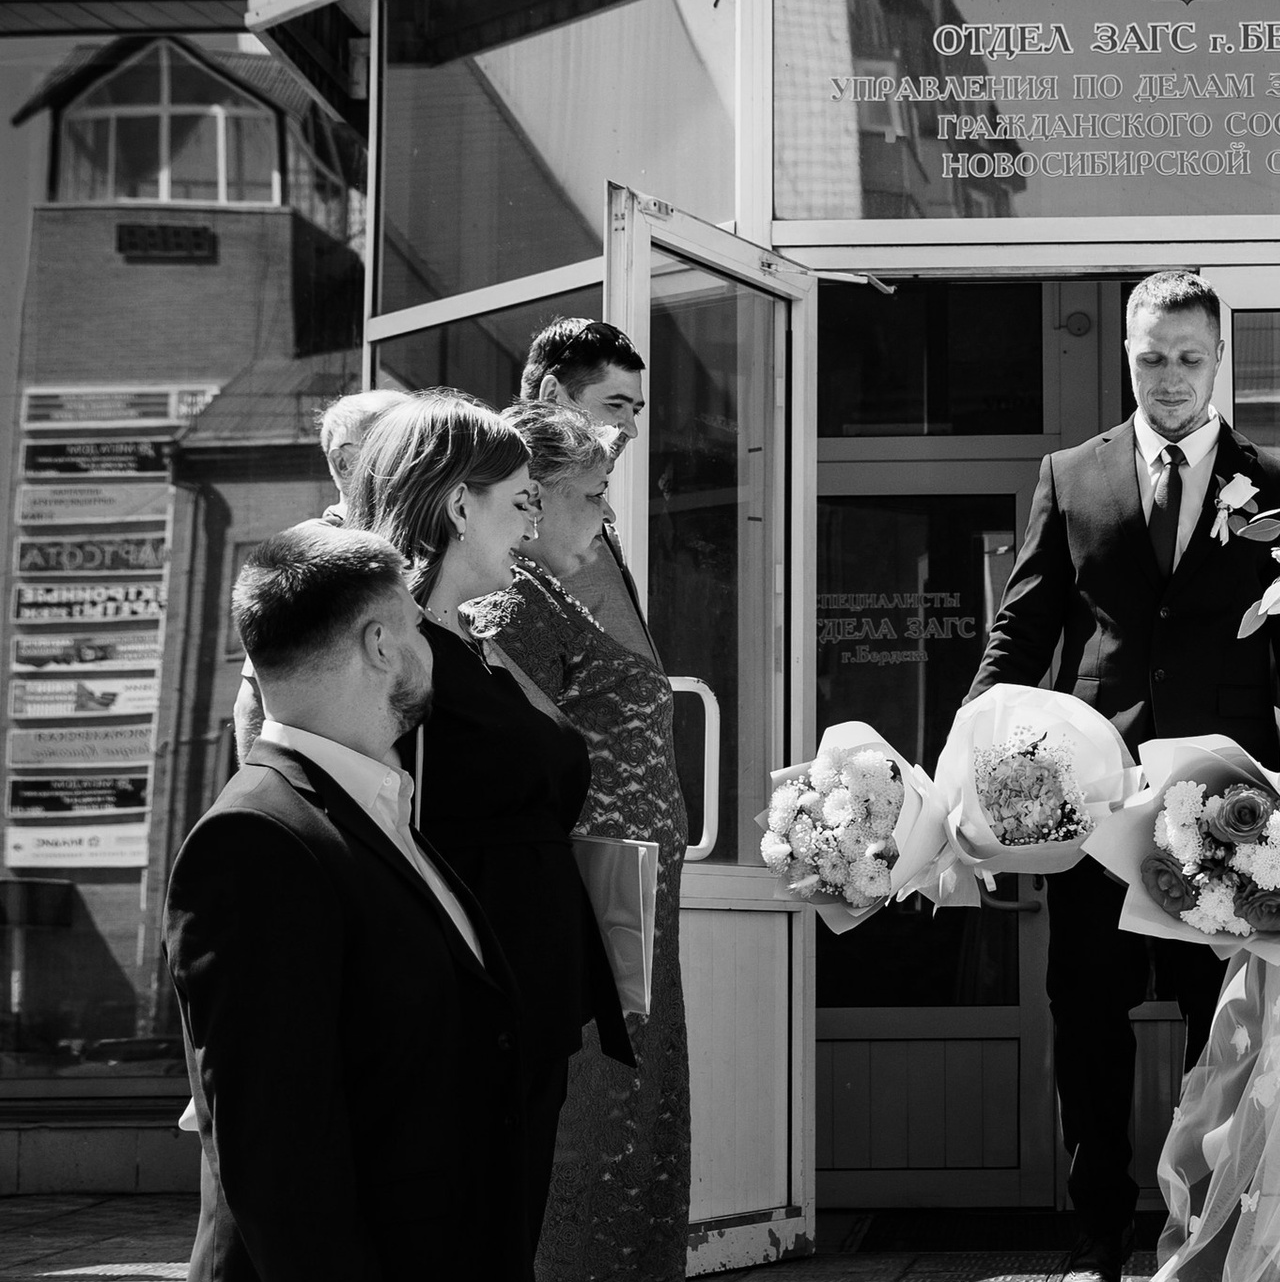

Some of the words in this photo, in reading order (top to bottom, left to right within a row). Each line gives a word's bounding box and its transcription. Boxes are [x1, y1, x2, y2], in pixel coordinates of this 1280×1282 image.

[933, 22, 1074, 61] ОТДЕЛ
[1090, 21, 1199, 54] ЗАГС
[829, 75, 1059, 102] УПРАВЛЕНИЯ
[1072, 74, 1124, 100] ПО
[1133, 73, 1255, 103] ДЕЛАМ
[937, 112, 1213, 142] ГРАЖДАНСКОГО
[941, 142, 1251, 179] НОВОСИБИРСКОЙ
[904, 617, 977, 639] ЗАГС
